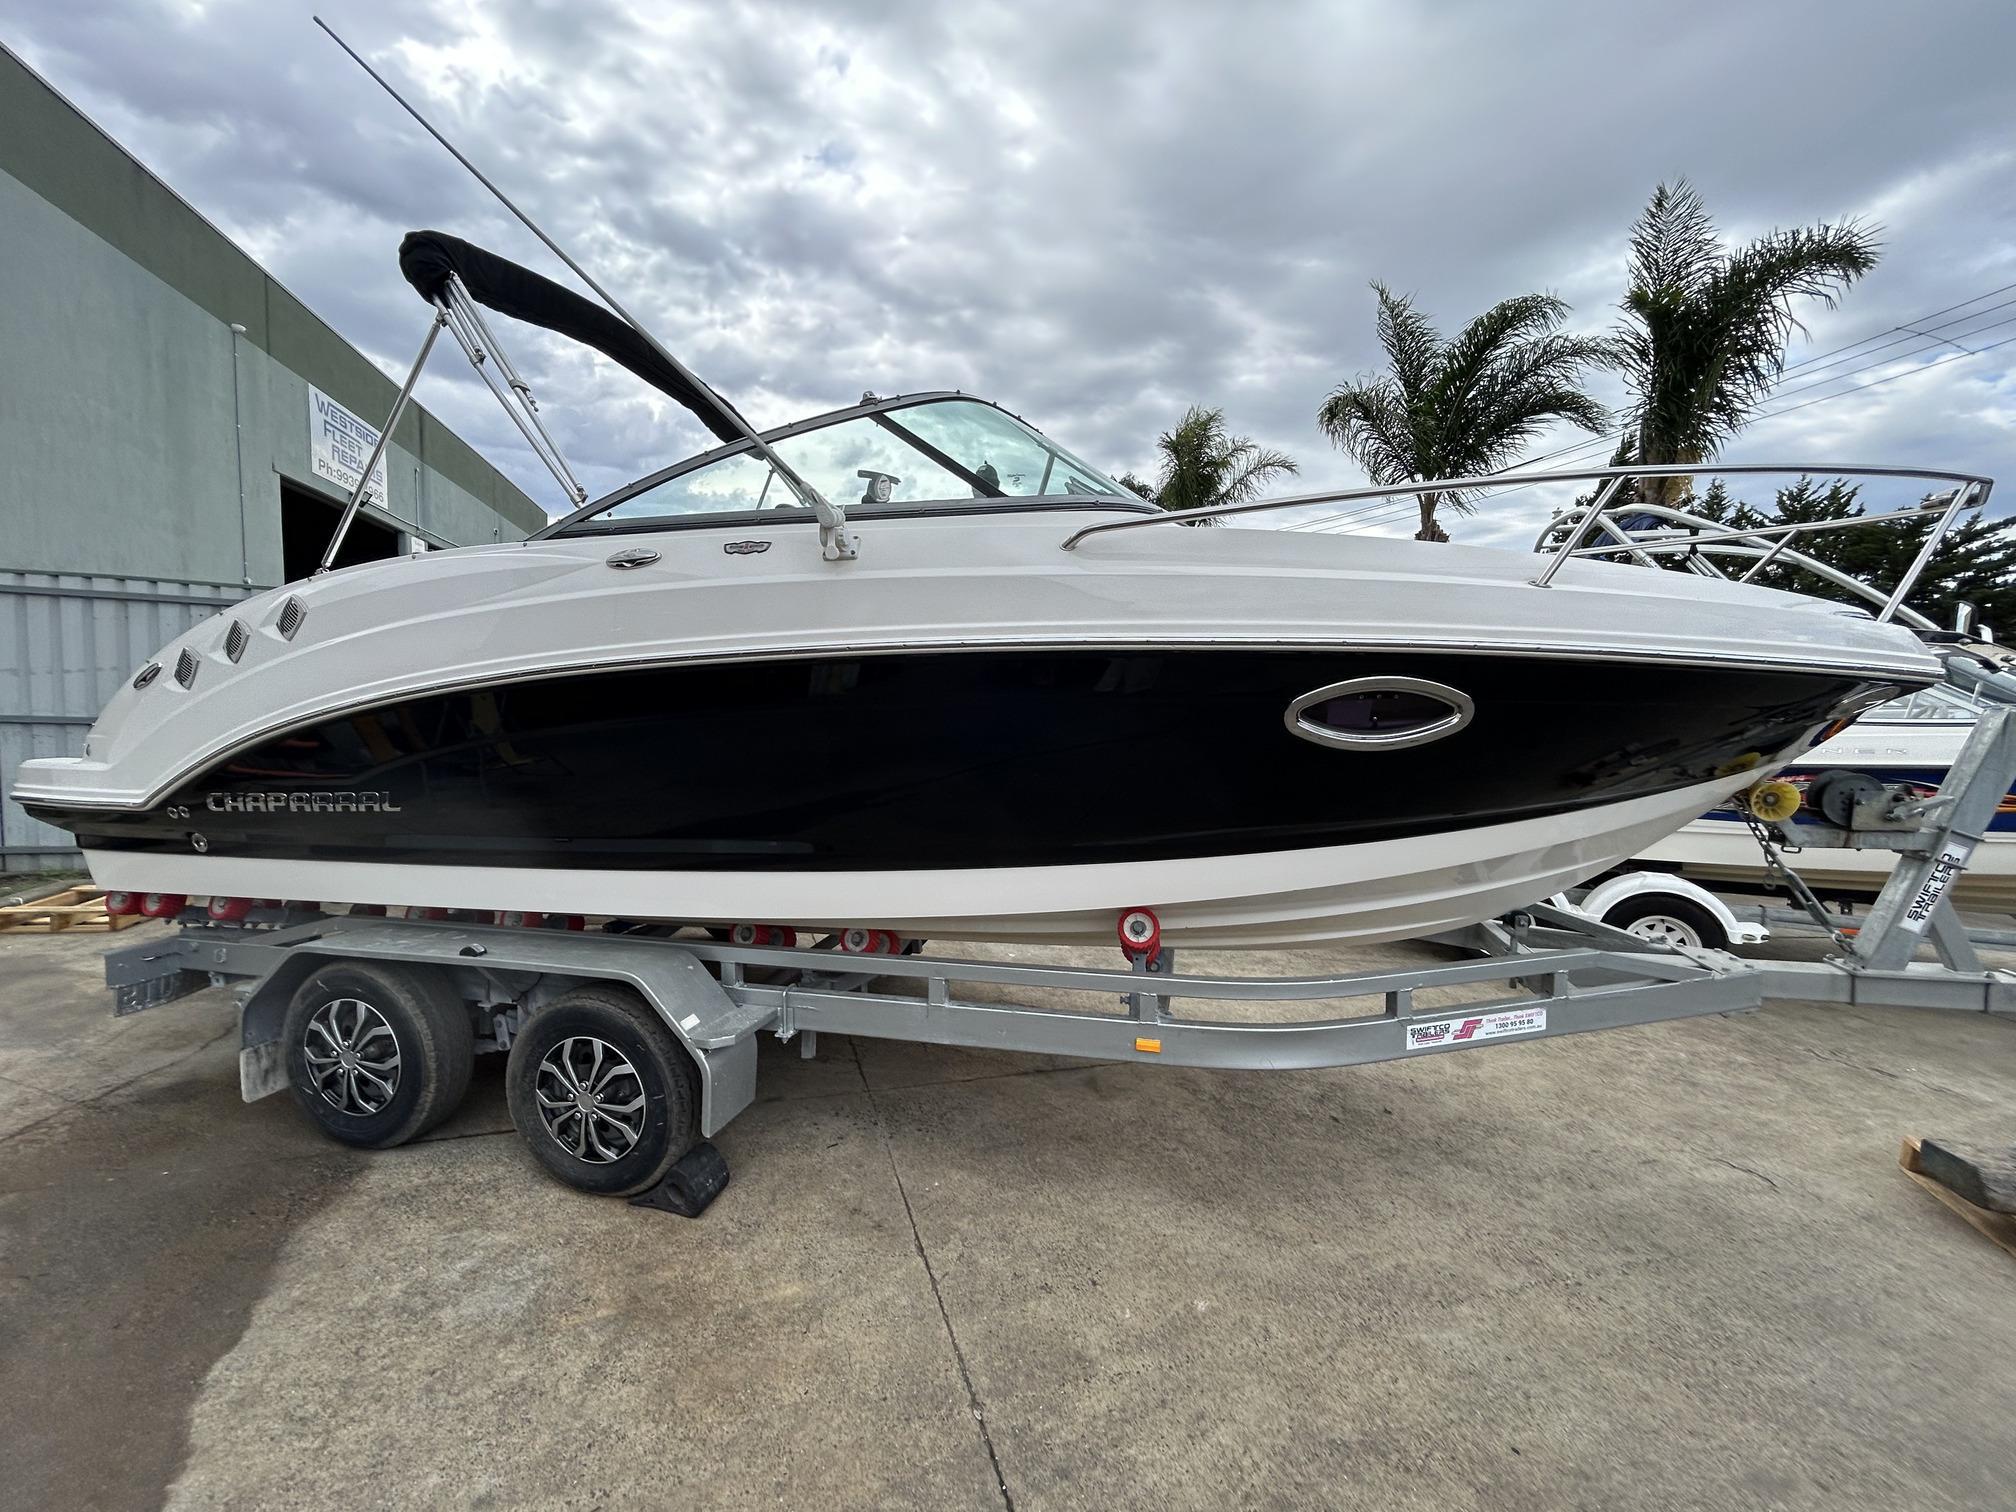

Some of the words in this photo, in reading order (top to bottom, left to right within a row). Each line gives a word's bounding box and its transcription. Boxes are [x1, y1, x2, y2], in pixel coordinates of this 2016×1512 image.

[324, 419, 363, 457] FLEET
[331, 445, 383, 486] REPAS
[206, 791, 401, 812] CHAPARRAL
[1410, 1023, 1450, 1035] SWIFTCO
